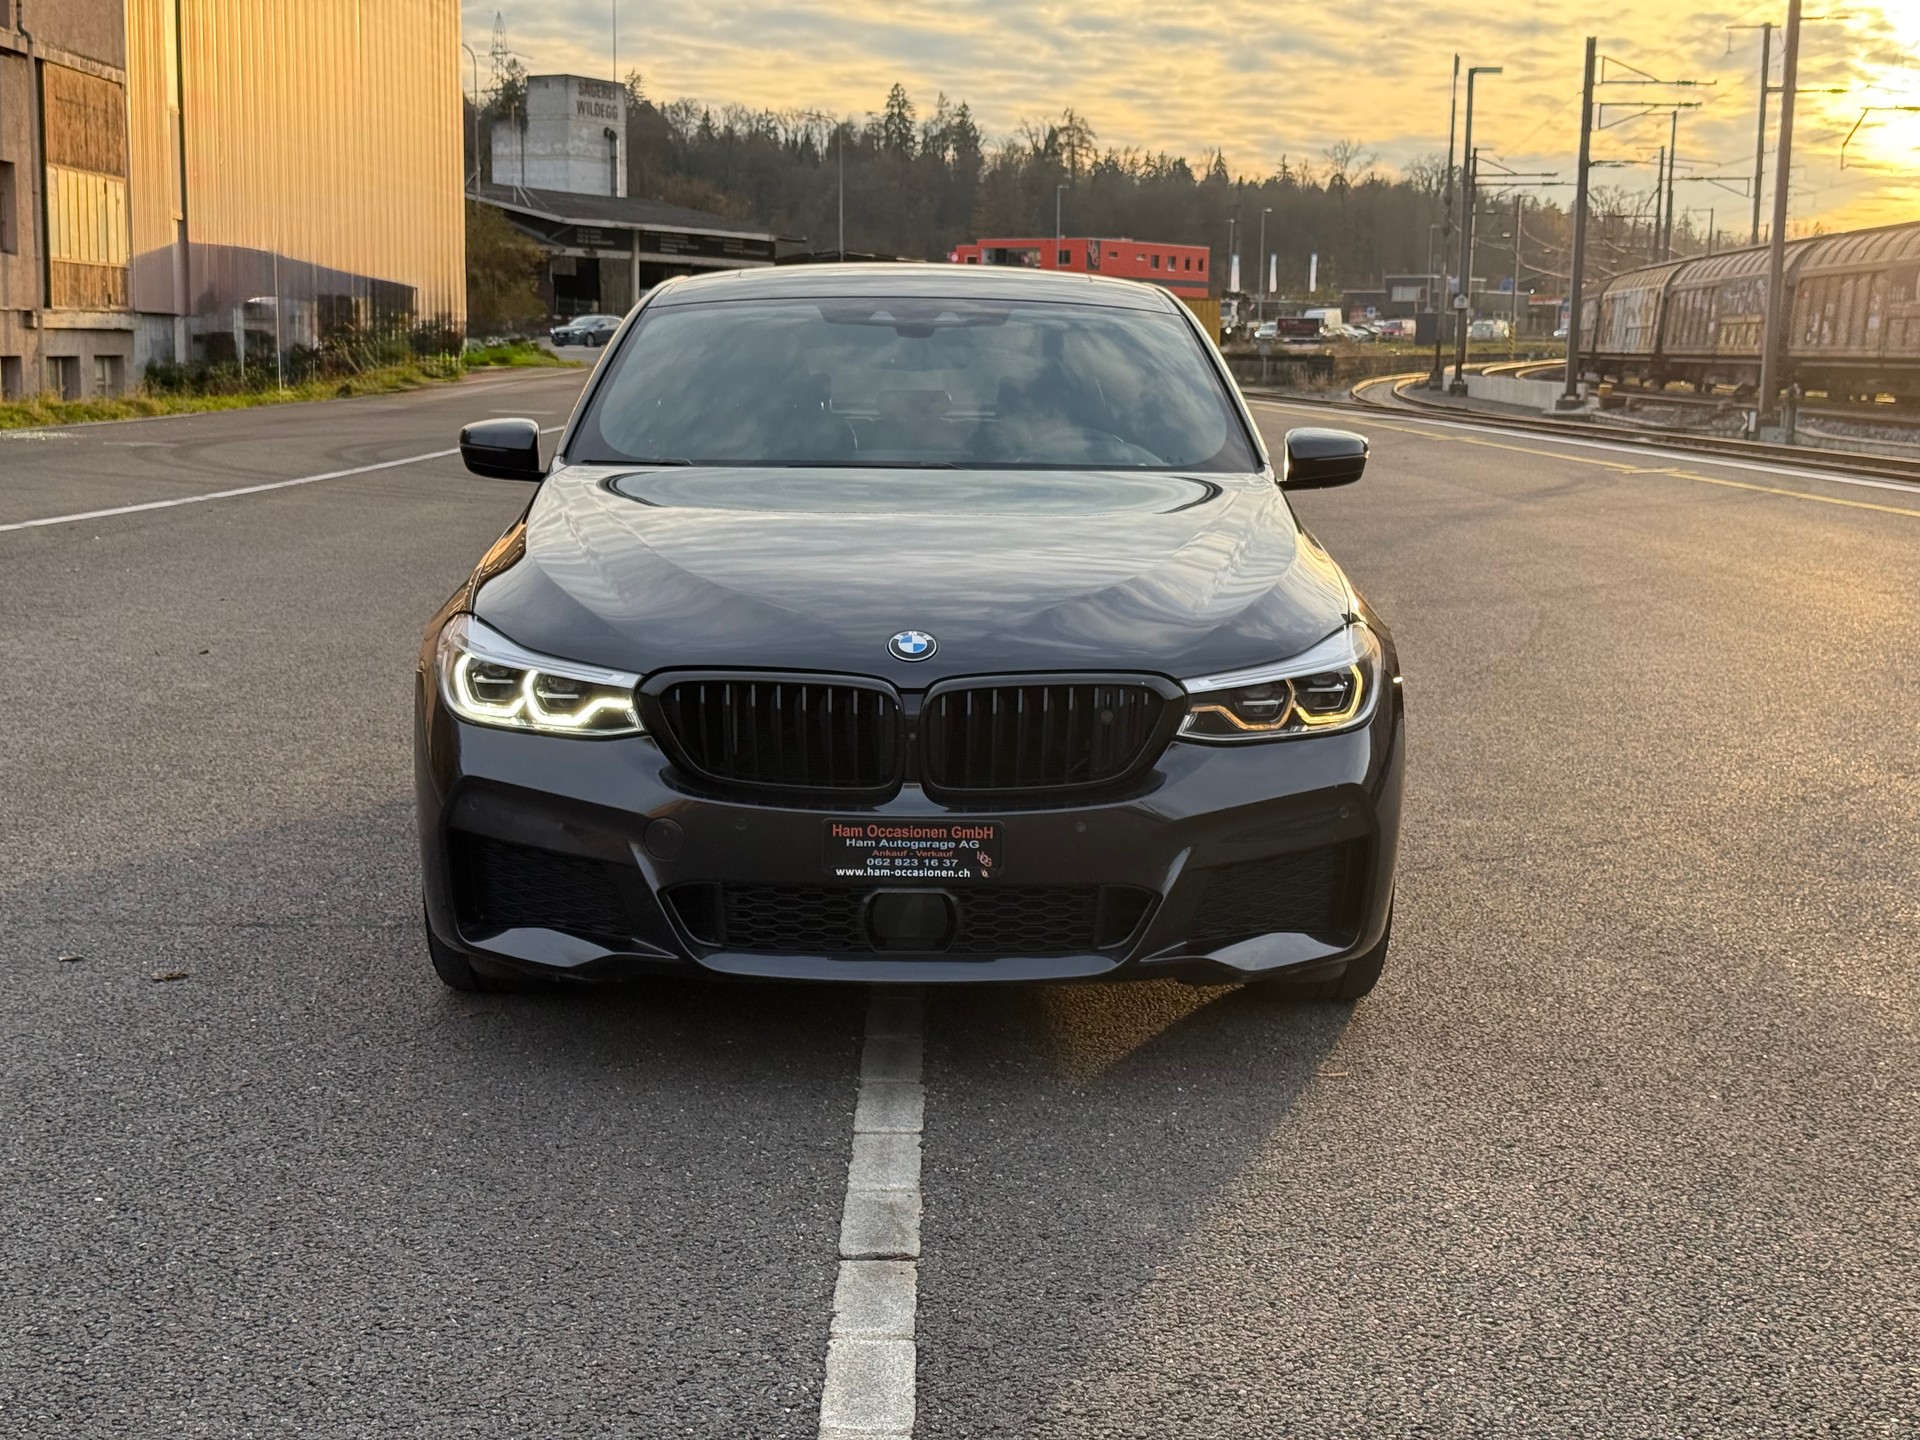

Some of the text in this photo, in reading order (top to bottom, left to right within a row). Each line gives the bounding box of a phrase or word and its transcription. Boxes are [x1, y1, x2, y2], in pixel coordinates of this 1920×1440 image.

[576, 101, 619, 120] WILDEGG
[894, 631, 933, 640] BMW
[832, 824, 994, 839] Ham Occasionen GmbH
[846, 838, 980, 849] Ham Autogarage AG
[867, 858, 959, 867] 062 823 16 37
[836, 867, 971, 878] www.ham-occasionen.ch
